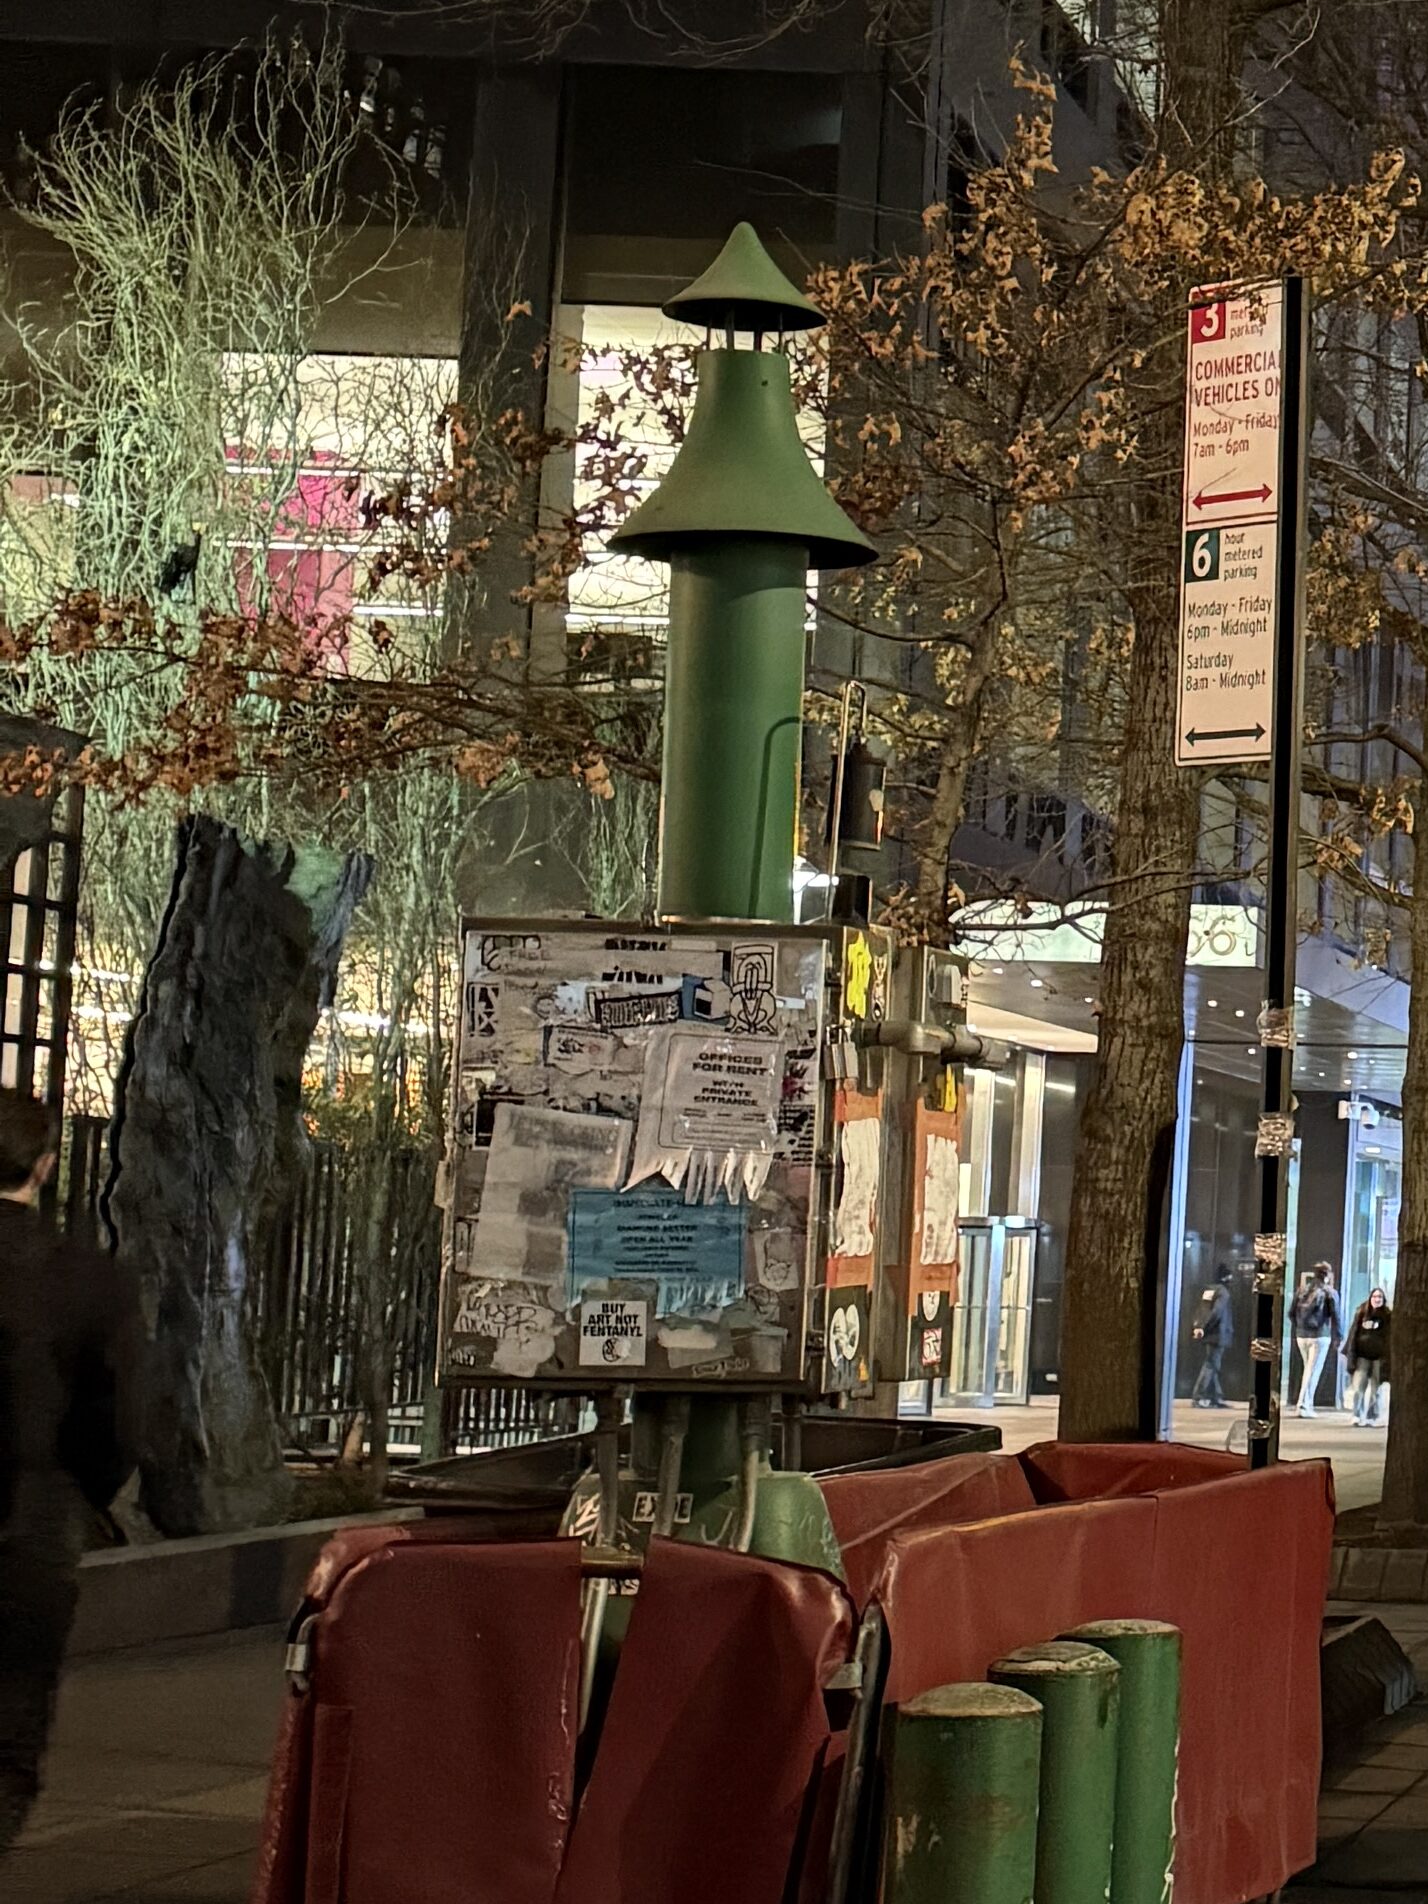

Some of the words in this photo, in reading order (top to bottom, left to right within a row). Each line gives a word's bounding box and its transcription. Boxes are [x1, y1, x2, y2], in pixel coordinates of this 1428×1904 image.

[1200, 302, 1220, 337] 3
[1195, 351, 1280, 382] COMMERCIA
[1195, 380, 1260, 407] VEHICLES
[1264, 377, 1281, 397] ON
[1193, 418, 1236, 437] Monday
[1193, 441, 1216, 458] 7am
[1225, 438, 1250, 456] 6pm
[1192, 532, 1212, 578] 6
[1224, 546, 1263, 562] metered
[1223, 564, 1258, 582] parking
[1188, 600, 1229, 619] Monday
[1239, 596, 1273, 616] Friday
[1187, 623, 1211, 643] 6pm
[1220, 616, 1267, 638] Midnight
[1186, 651, 1234, 671] Saturday
[1185, 674, 1209, 692] 8am
[1218, 668, 1266, 690] Midnight
[692, 1062, 722, 1072] FOR
[727, 1065, 768, 1076] RENT
[602, 1303, 626, 1313] BUY
[588, 1314, 613, 1325] ART
[615, 1314, 639, 1325] NOT
[583, 1325, 643, 1337] FENTANYL
